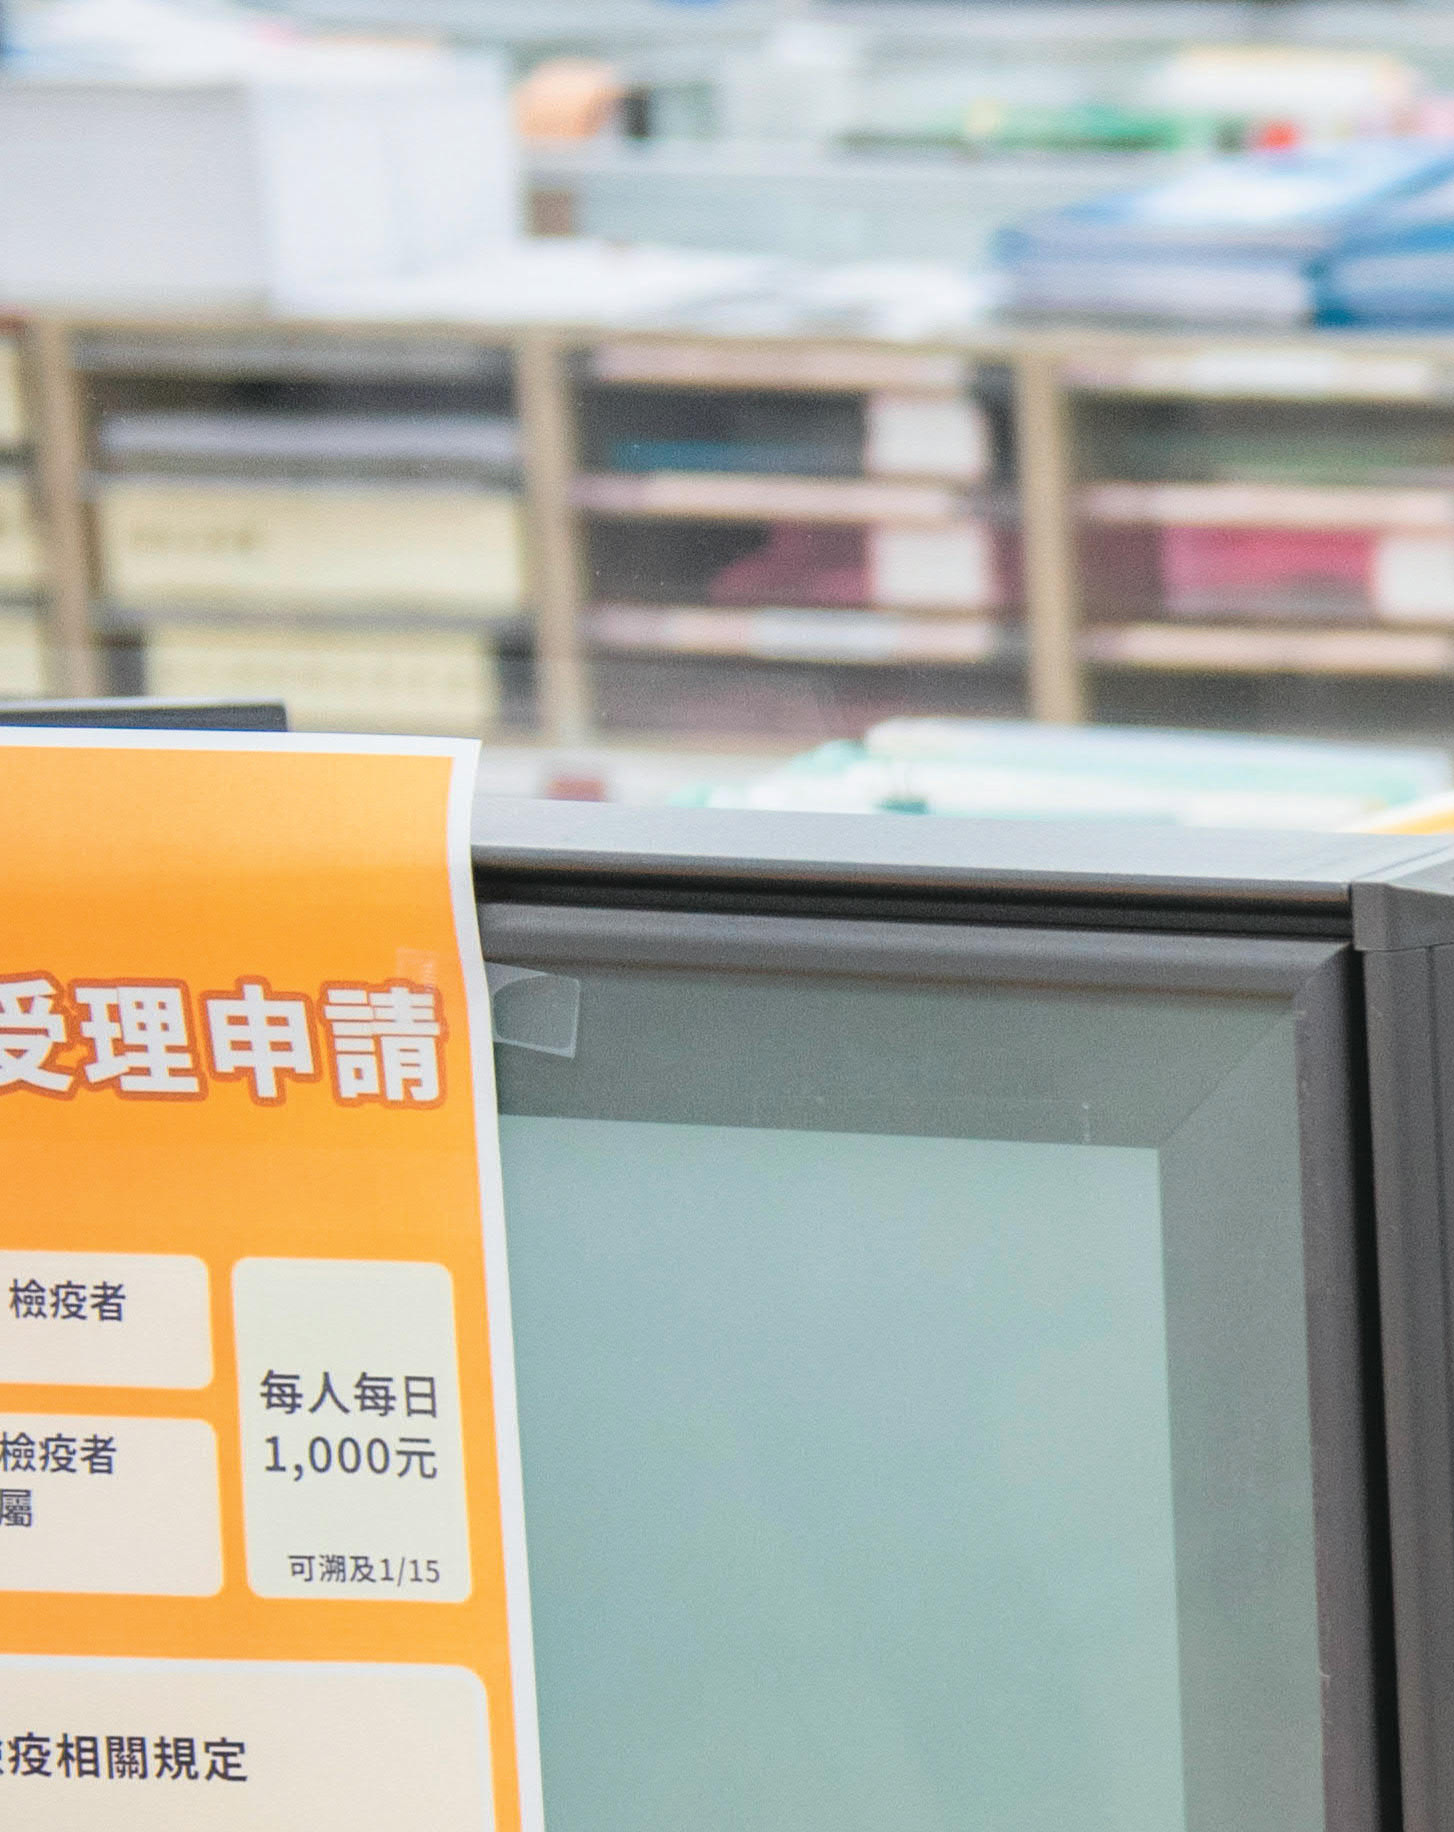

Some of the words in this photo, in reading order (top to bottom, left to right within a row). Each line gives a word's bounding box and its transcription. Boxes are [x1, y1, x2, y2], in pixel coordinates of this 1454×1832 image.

[0, 976, 443, 1105] 受理申請
[9, 1278, 126, 1322] 檢疫者
[260, 1369, 437, 1418] 每人每日
[0, 1431, 117, 1475] 檢疫者
[265, 1436, 438, 1482] 1,000元
[288, 1554, 441, 1587] 可溯及1/15
[0, 1731, 248, 1782] 疫相關規定
